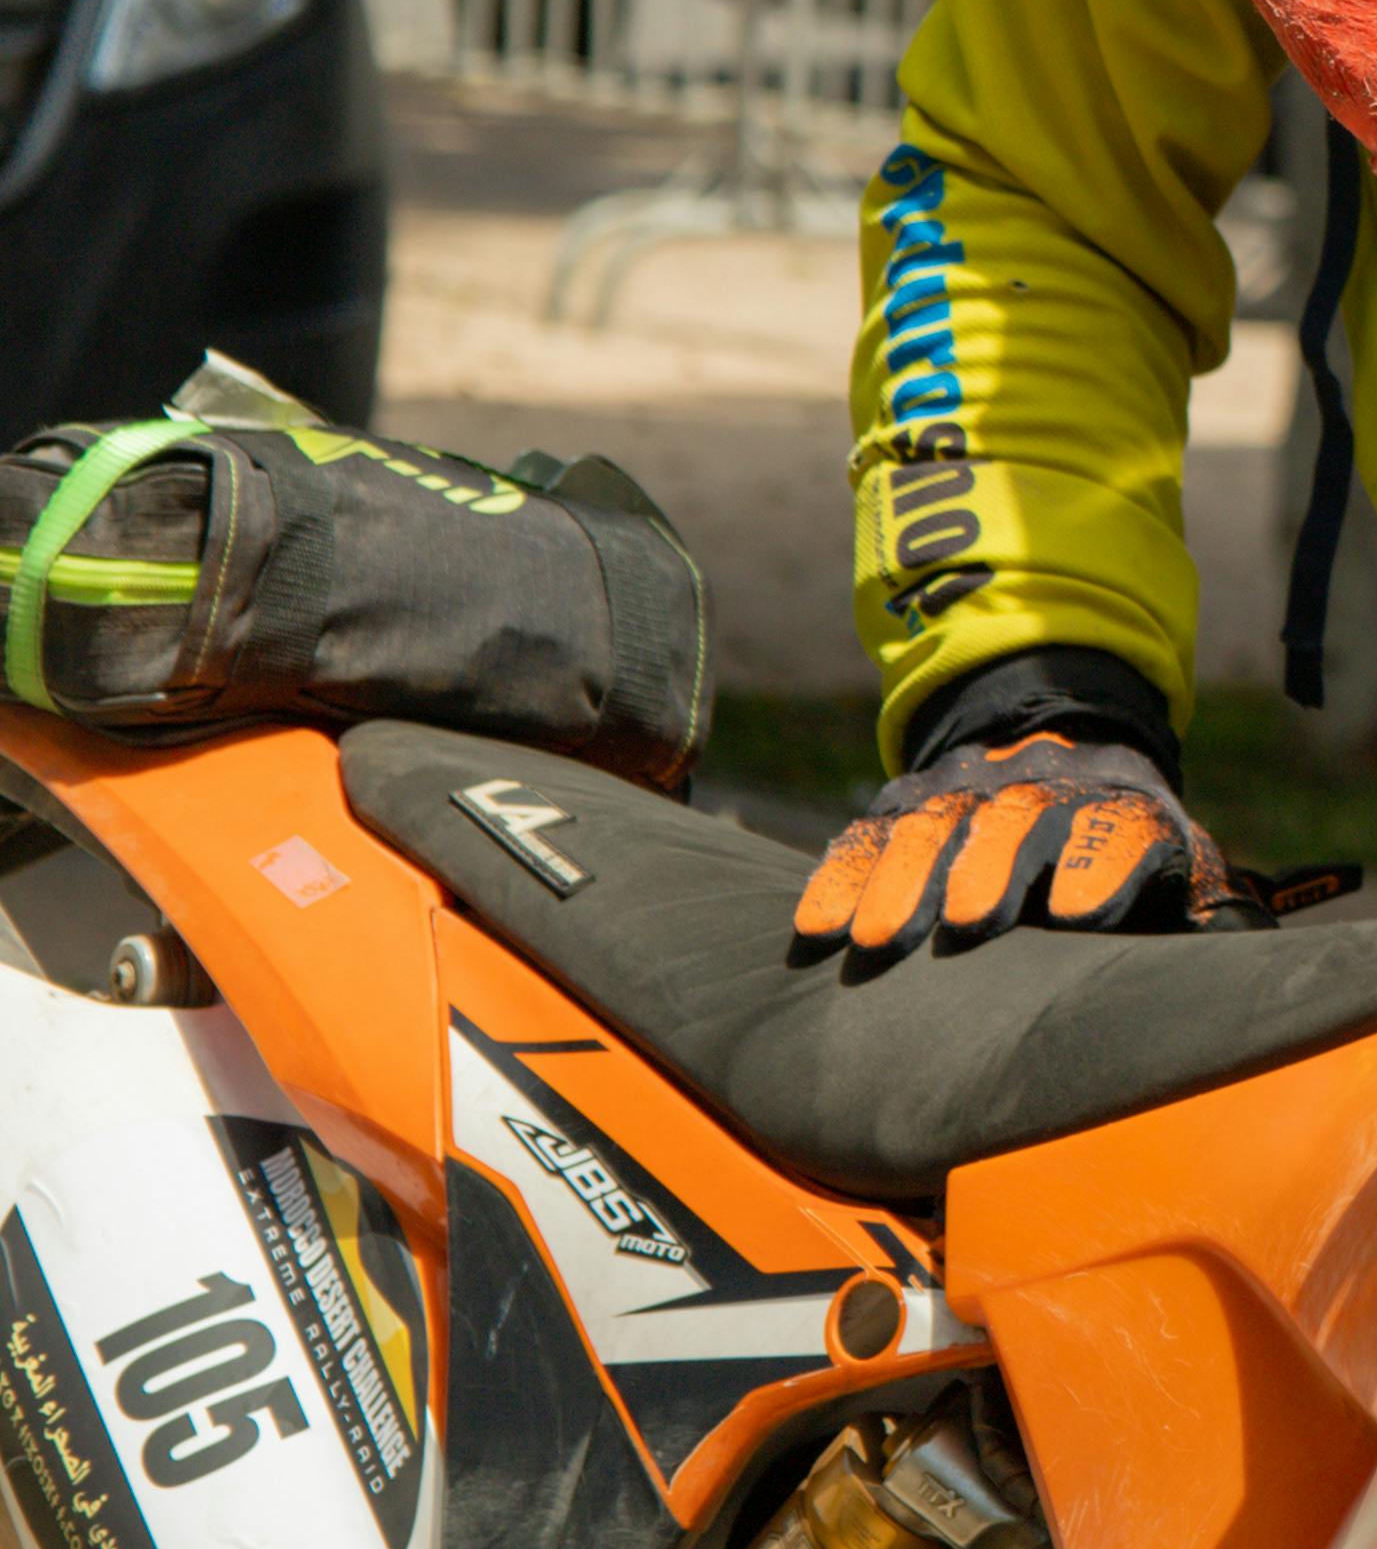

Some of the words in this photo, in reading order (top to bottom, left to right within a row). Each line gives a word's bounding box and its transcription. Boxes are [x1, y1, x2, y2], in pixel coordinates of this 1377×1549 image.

[7, 1313, 56, 1399] المغربية
[94, 1270, 311, 1489] 105
[239, 1167, 306, 1306] EXTREME
[304, 1322, 385, 1495] RALLY-RAID
[260, 1147, 328, 1269] MOROCCO
[304, 1258, 360, 1352] DESERT
[341, 1337, 411, 1480] CHALLENGE
[39, 1401, 91, 1486] الصحراء
